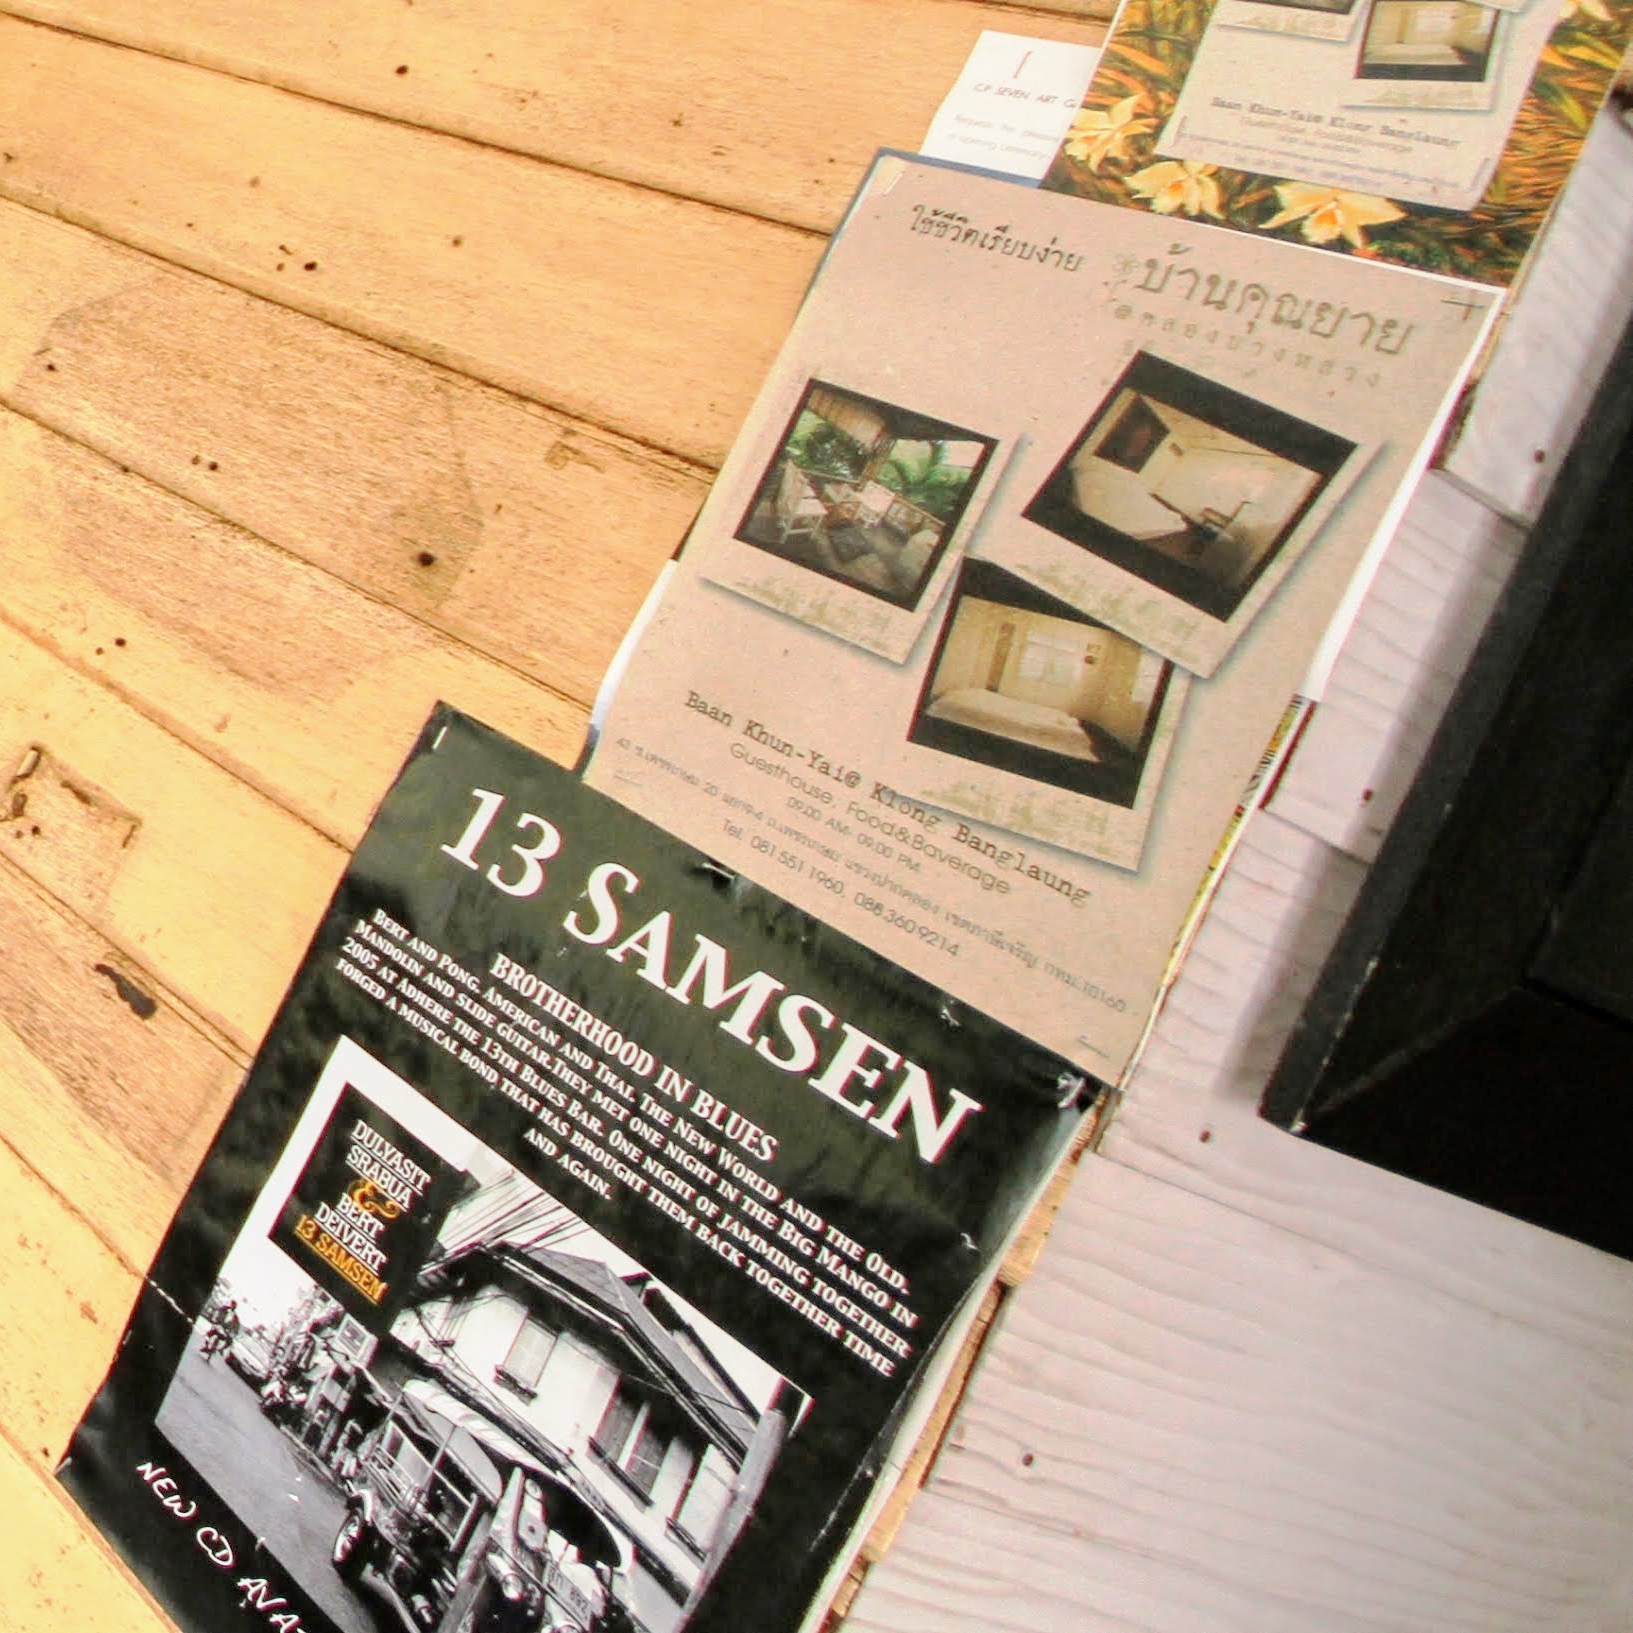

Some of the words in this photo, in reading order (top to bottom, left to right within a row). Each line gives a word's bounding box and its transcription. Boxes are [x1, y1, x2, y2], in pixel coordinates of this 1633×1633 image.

[910, 204, 1084, 272] ใช้ชีวิตเรียบง่าย
[1134, 242, 1415, 357] บ้านคุณยาย
[684, 690, 733, 727] Baan
[869, 781, 941, 834] Klong
[951, 822, 1091, 908] Banglaung
[440, 787, 561, 900] 13
[562, 861, 982, 1167] SAMSEN
[354, 920, 424, 976] MANDOLIN
[422, 972, 455, 998] AND
[455, 993, 497, 1028] SLIDE
[591, 1089, 630, 1122] MET
[629, 1117, 664, 1148] ONE
[663, 1141, 718, 1185] NIGHT
[716, 1178, 740, 1202] IN
[741, 1195, 778, 1230] THE
[777, 1219, 816, 1256] BIG
[816, 1246, 889, 1307] MANGO
[890, 1302, 918, 1327] IN
[372, 909, 409, 941] BERT
[406, 937, 439, 962] AND
[437, 954, 480, 994] PONG.
[482, 988, 560, 1047] AMERICAN
[558, 1042, 594, 1070] AND
[594, 1063, 635, 1103] THAI.
[639, 1094, 673, 1127] THE
[672, 1119, 716, 1154] NEW
[718, 1148, 779, 1201] WORLD
[779, 1198, 823, 1231] AND
[825, 1225, 864, 1261] THE
[866, 1253, 908, 1294] OLD.
[491, 954, 654, 1076] BROTHERHOOD
[654, 1065, 693, 1102] IN
[690, 1089, 777, 1161] BLUES
[335, 958, 386, 1000] FORGED
[385, 996, 397, 1011] A
[398, 1003, 459, 1055] MUSICAL
[500, 1077, 540, 1112] THAT
[537, 1106, 570, 1136] HAS
[570, 1130, 647, 1192] BROUGHT
[647, 1186, 696, 1230] THEM
[695, 1223, 745, 1267] BACK
[746, 1260, 841, 1337] TOGETHER
[843, 1330, 894, 1377] TIME
[336, 1192, 386, 1239] BERT
[342, 937, 380, 970] 2005
[376, 966, 398, 984] AT
[396, 978, 453, 1024] ADHERE
[452, 1017, 481, 1045] THE
[480, 1037, 520, 1074] 13TH
[519, 1065, 568, 1108] BLUES
[567, 1099, 604, 1137] BAR.
[608, 1129, 643, 1163] ONE
[642, 1156, 696, 1200] NIGHT
[695, 1195, 720, 1218] OF
[718, 1214, 810, 1284] JAMMING
[812, 1278, 909, 1357] TOGETHER
[346, 1144, 416, 1209] SRABUA
[351, 1119, 432, 1192] DULYASIT
[524, 1128, 557, 1156] AND
[557, 1154, 611, 1200] AGAIN.
[295, 1214, 319, 1241] 13
[315, 1233, 389, 1301] SAMSEN
[314, 1201, 388, 1272] DEIVERT
[136, 1461, 198, 1518] NEW
[196, 1526, 235, 1567] CD
[237, 1576, 309, 1633] AVA
